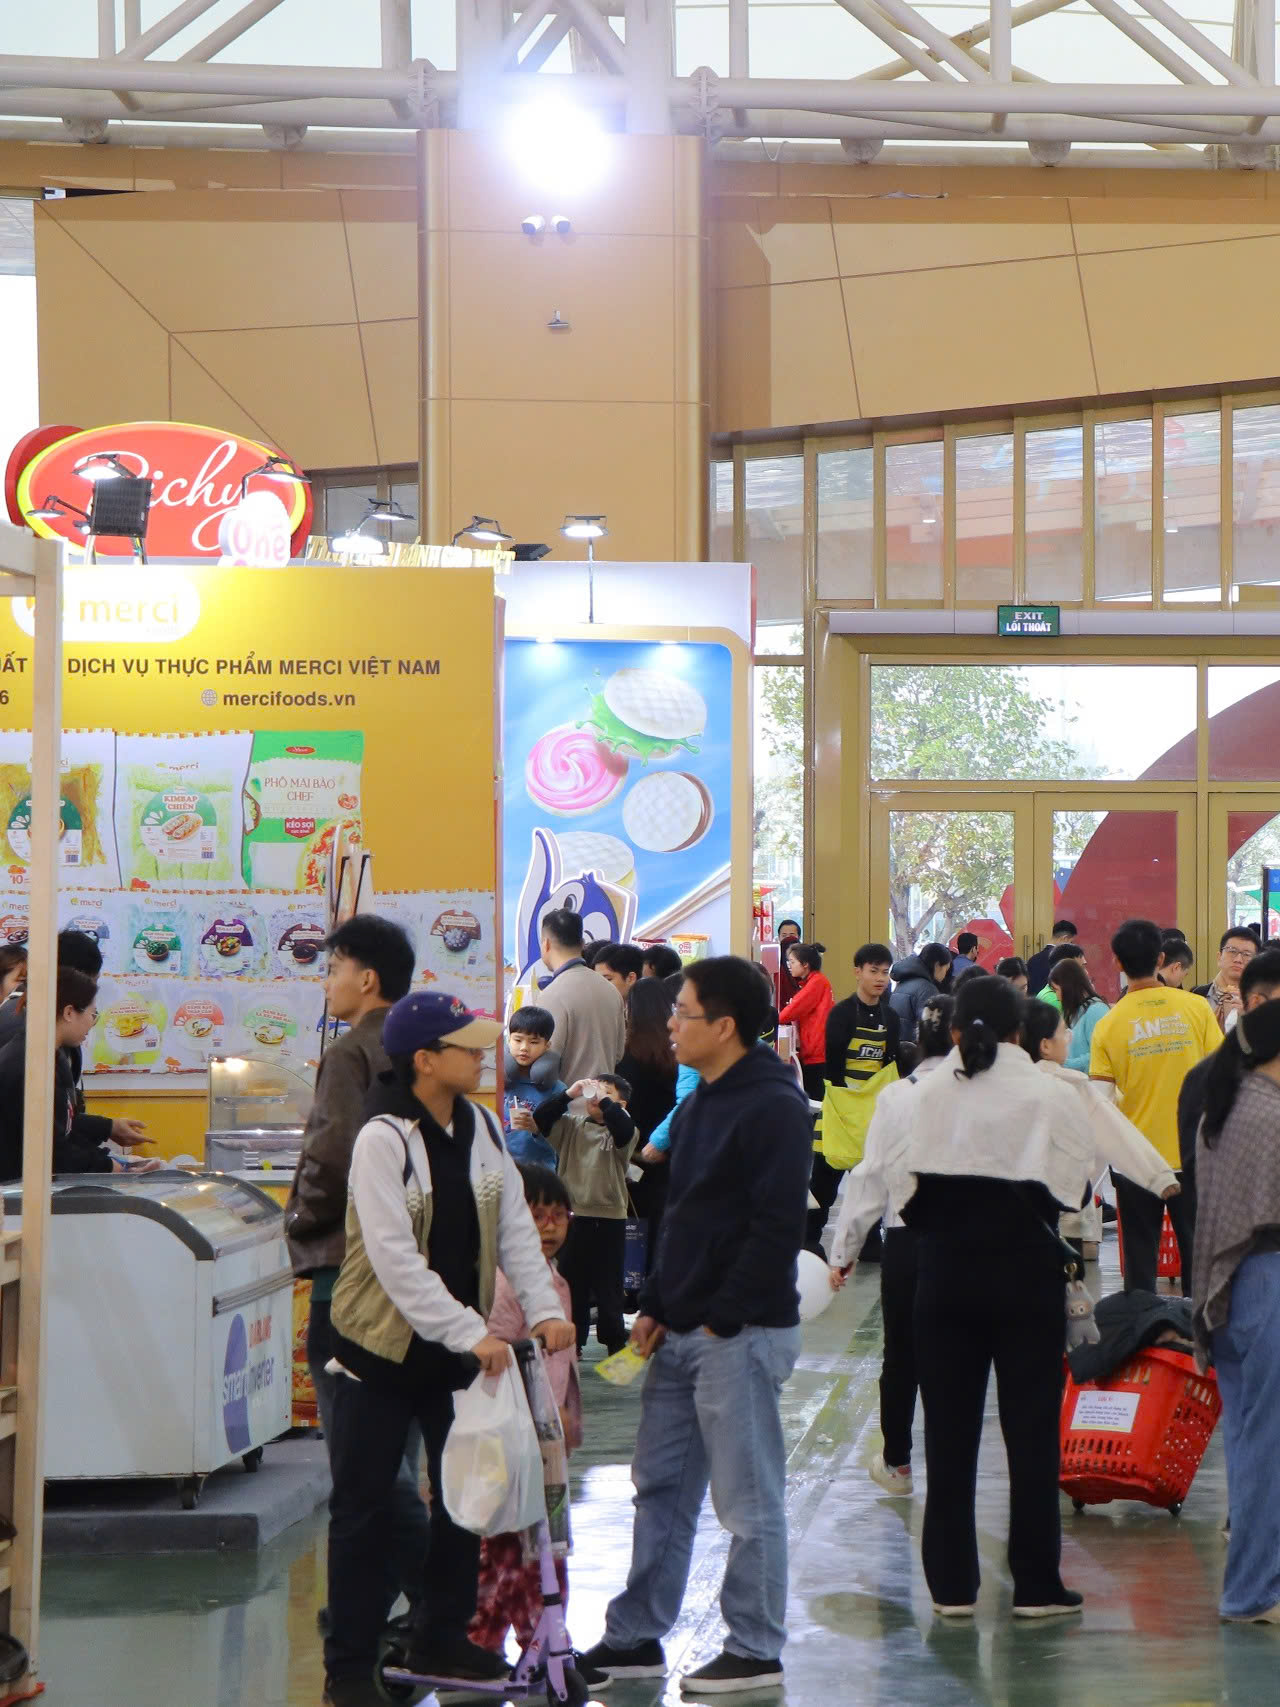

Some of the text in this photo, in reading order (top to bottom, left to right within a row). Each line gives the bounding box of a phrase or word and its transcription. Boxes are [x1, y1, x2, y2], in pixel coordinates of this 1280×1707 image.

[79, 594, 179, 624] merci
[1014, 611, 1044, 620] EXIT
[1006, 619, 1052, 632] LỐI THOÁT
[0, 650, 441, 678] ẤT DỊCH VỤ THỰC PHẨM MERCI VIỆT NAM
[223, 691, 356, 706] mercifoods.vn
[290, 777, 311, 788] MAI
[287, 791, 313, 801] CHEF
[9, 902, 30, 911] merc
